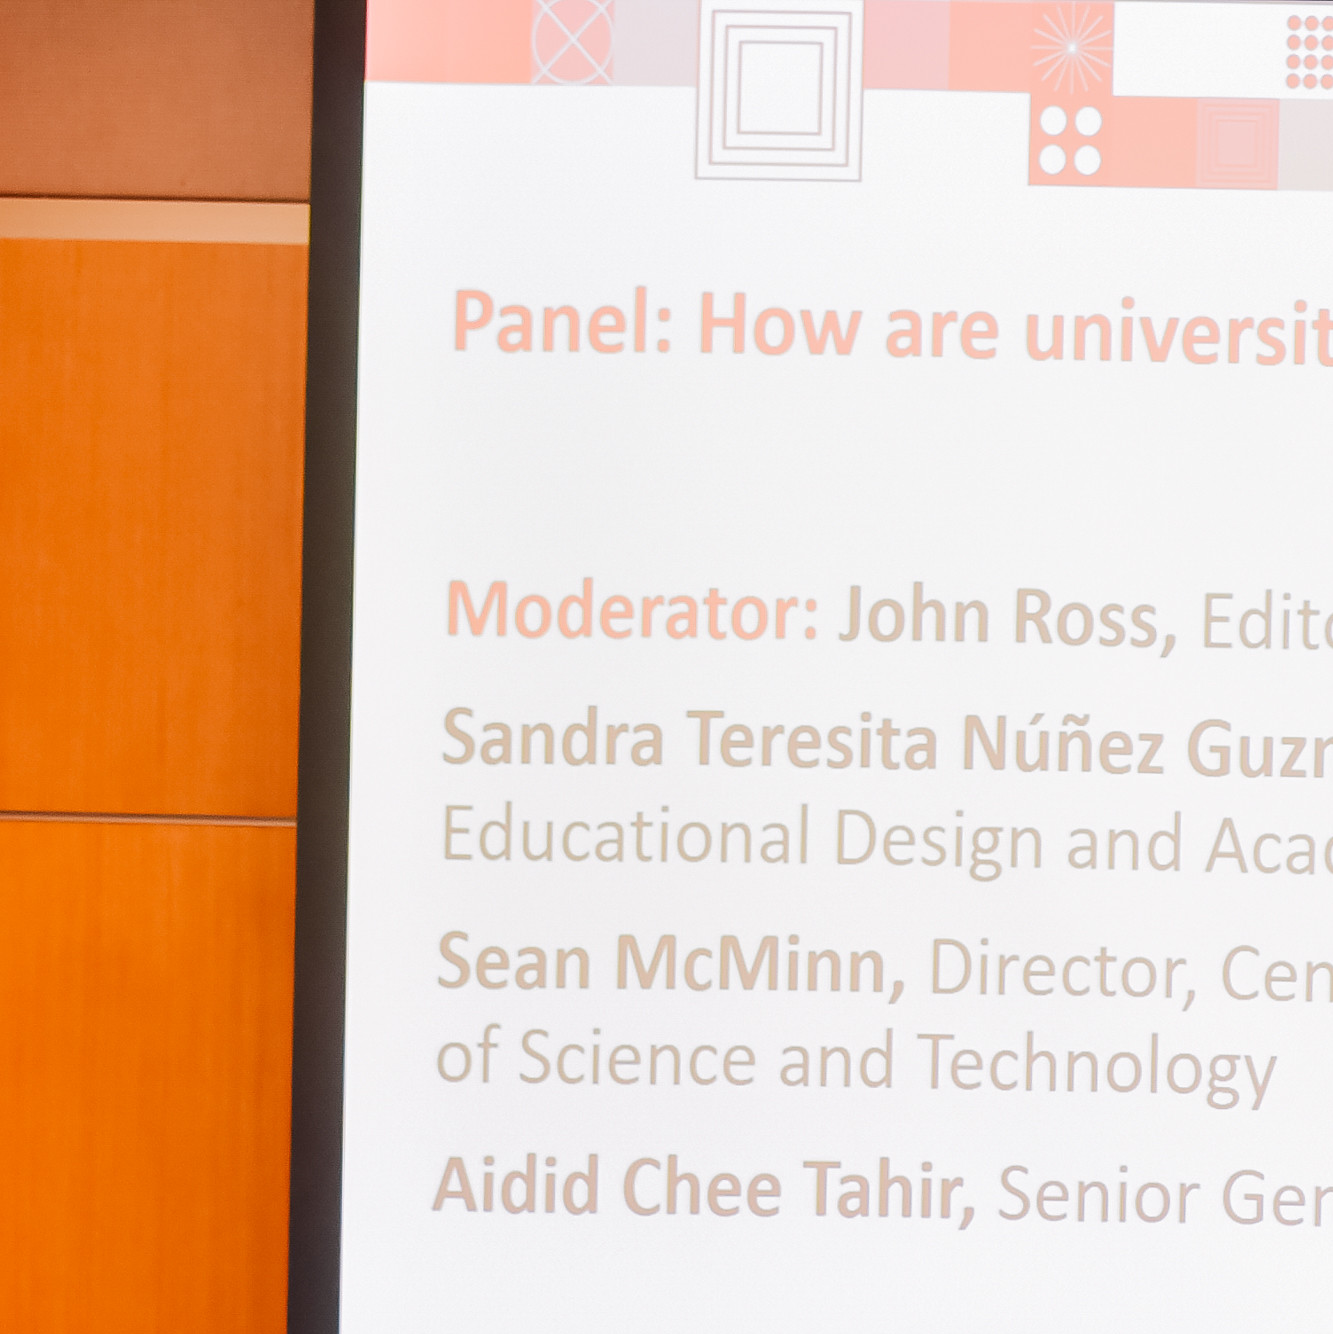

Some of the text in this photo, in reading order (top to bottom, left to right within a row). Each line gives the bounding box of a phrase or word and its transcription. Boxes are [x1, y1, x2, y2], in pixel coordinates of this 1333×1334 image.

[455, 285, 671, 354] Panel:
[700, 292, 862, 356] How
[886, 309, 998, 359] are
[447, 577, 817, 641] Moderator:
[839, 581, 988, 642] John
[1015, 588, 1175, 658] Ross,
[442, 705, 663, 767] Sandra
[686, 710, 936, 771] Teresita
[963, 713, 1164, 774] Núñez
[444, 801, 808, 864] Educational
[837, 809, 1041, 882] Design
[1068, 811, 1181, 871] and
[438, 930, 589, 990] Sean
[617, 934, 904, 1004] McMinn,
[932, 938, 1195, 1012] Director,
[437, 1023, 1277, 1110] of Science and Technology
[431, 1152, 598, 1216] Aidid
[623, 1154, 781, 1217] Chee
[803, 1157, 974, 1230] Tahir,
[999, 1165, 1200, 1223] Senior
